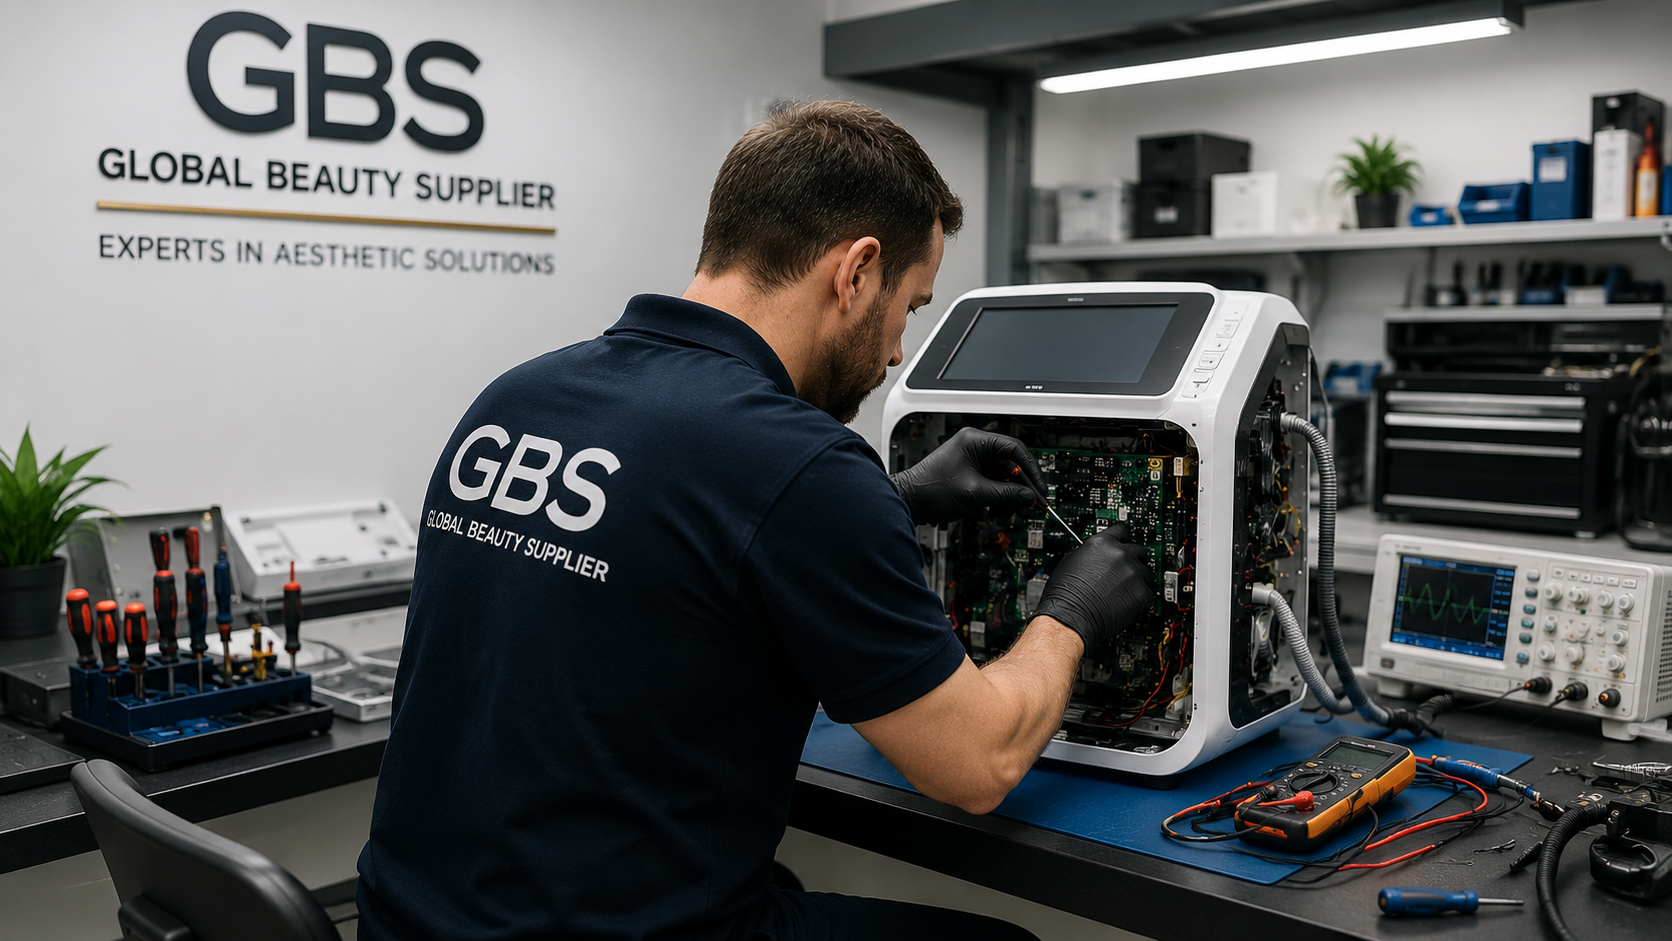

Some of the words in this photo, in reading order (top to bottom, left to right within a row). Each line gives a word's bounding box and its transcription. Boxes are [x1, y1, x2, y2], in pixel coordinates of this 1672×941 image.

[187, 11, 485, 152] GBS
[98, 147, 252, 188] GLOBAL
[267, 160, 402, 198] BEAUTY
[415, 173, 556, 210] SUPPLIER
[99, 234, 225, 264] EXPERTS
[236, 240, 263, 264] IN
[274, 242, 414, 270] AESTHETIC
[425, 248, 555, 275] SOLUTIONS
[449, 424, 621, 532] GBS
[426, 509, 463, 535] GLOBAL
[467, 520, 525, 552] BEAUTY
[524, 538, 609, 582] SUPPLIER
